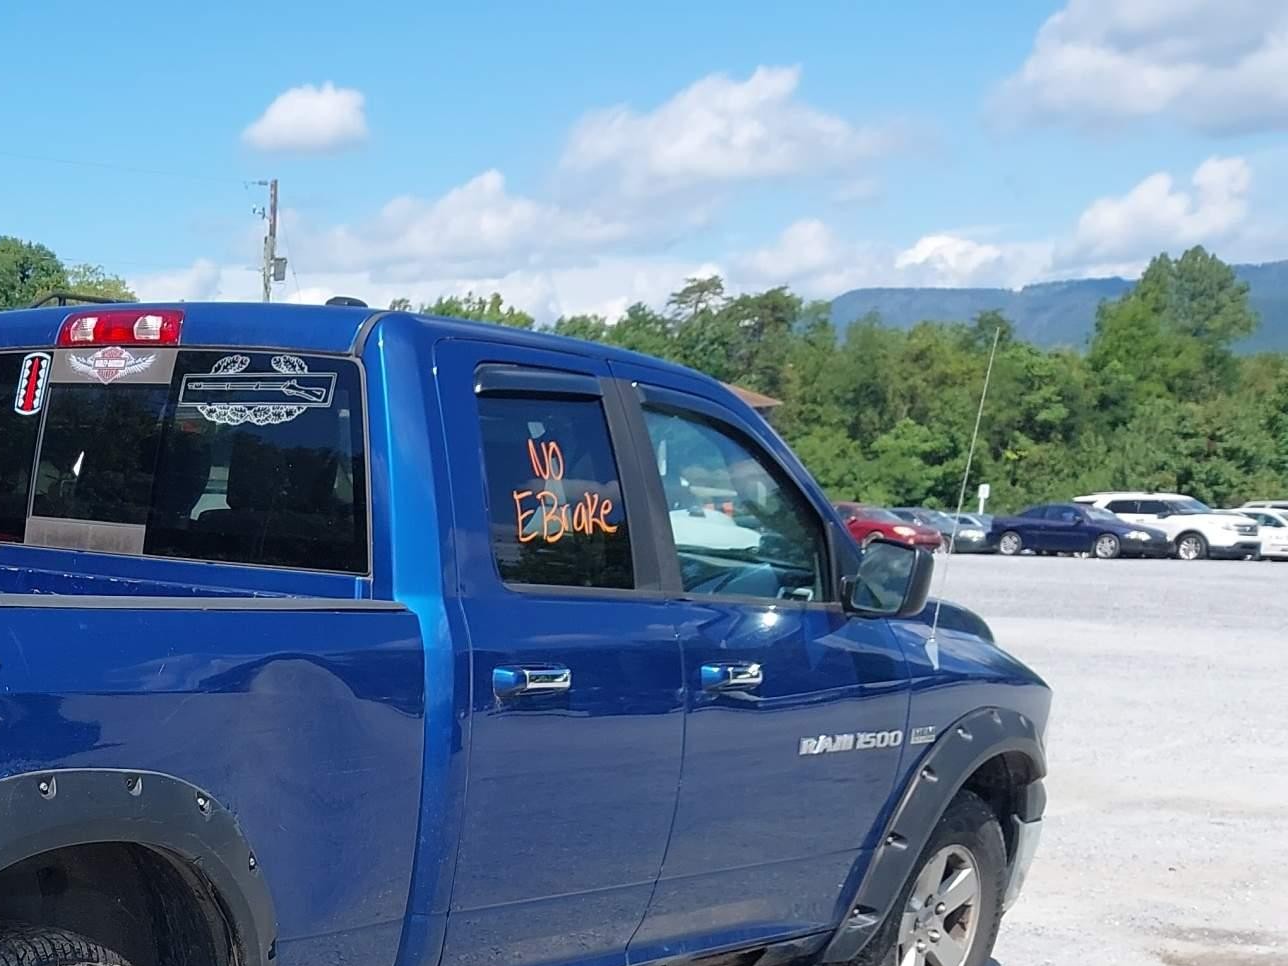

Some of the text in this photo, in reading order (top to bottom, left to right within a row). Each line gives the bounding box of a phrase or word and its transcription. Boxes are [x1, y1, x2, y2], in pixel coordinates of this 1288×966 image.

[528, 439, 565, 480] NO
[800, 733, 854, 755] RAM
[856, 730, 903, 749] 1500
